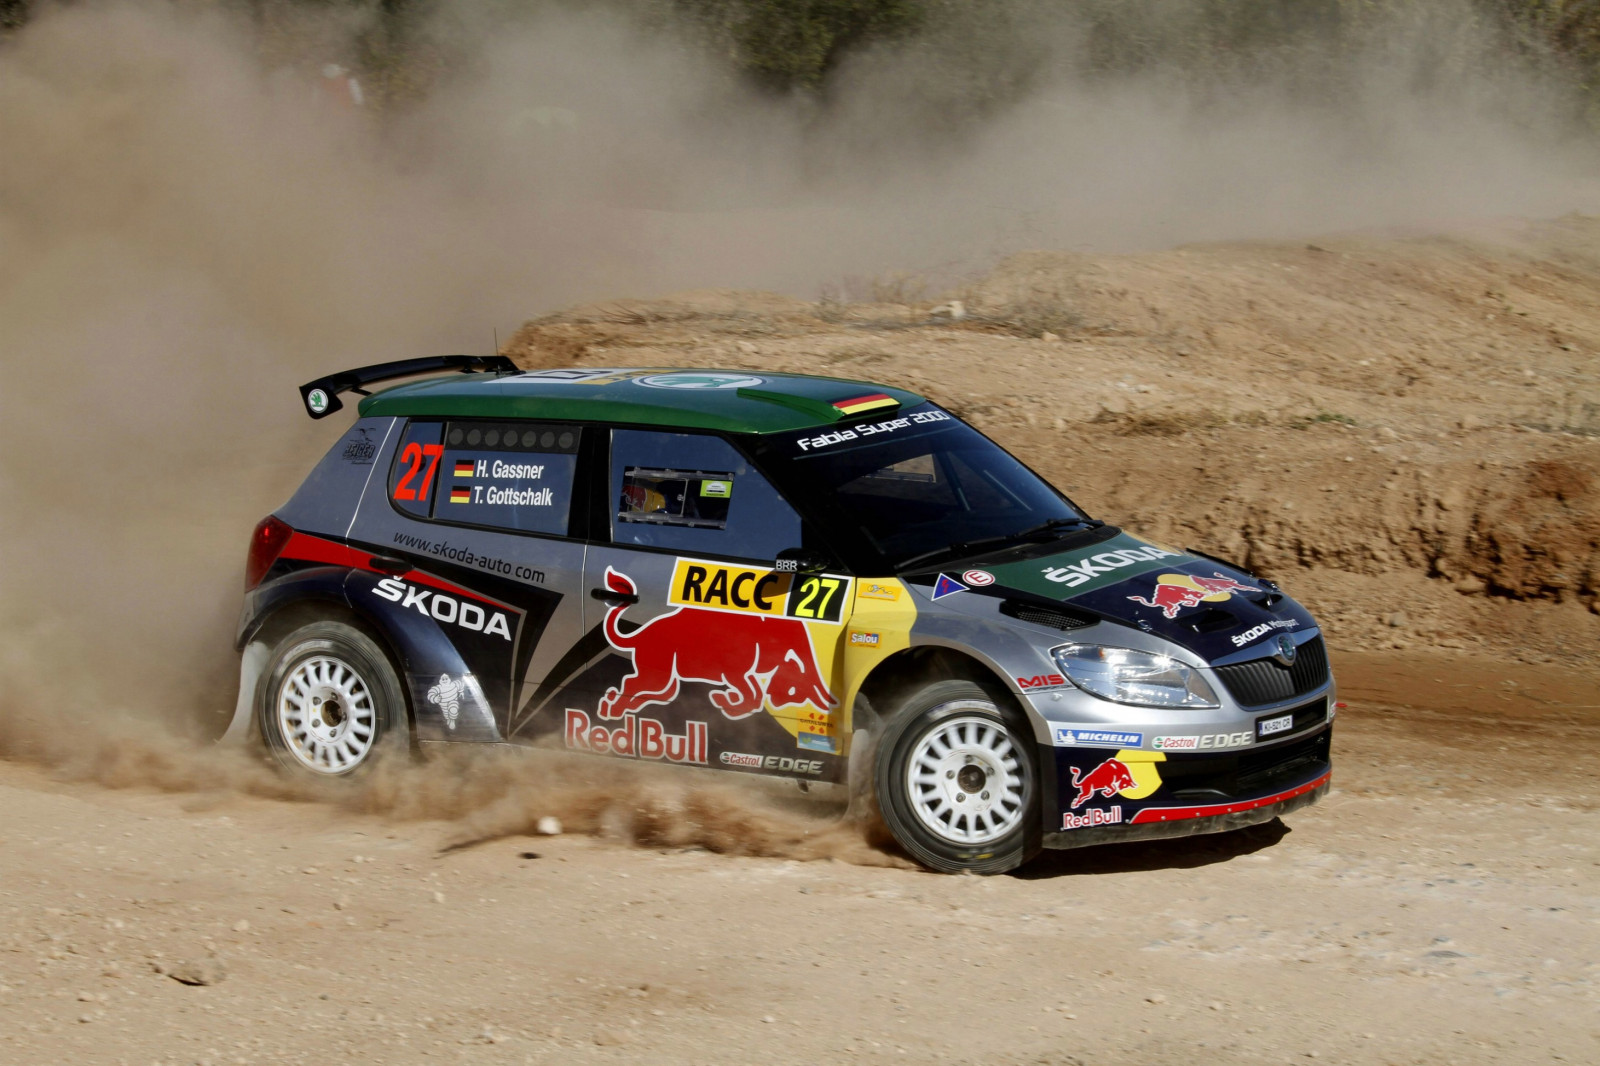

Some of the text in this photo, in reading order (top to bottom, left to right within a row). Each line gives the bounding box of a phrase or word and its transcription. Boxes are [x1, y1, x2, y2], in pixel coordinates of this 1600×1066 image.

[796, 410, 951, 450] Fabia Super 2000
[393, 442, 444, 501] 27
[476, 460, 544, 480] H. Gassner
[474, 486, 554, 506] T. Gottschalk
[776, 560, 798, 571] BRR
[1040, 546, 1181, 588] ŠKODA
[681, 565, 779, 611] RACC
[795, 576, 840, 619] 27
[371, 575, 512, 641] ŠKODA
[851, 633, 879, 644] Salou
[1231, 623, 1273, 647] ŠKODA
[1017, 674, 1065, 688] MIS
[565, 707, 708, 765] Red Bull
[1077, 732, 1140, 743] MICHELIN
[1164, 731, 1254, 749] Castrol EDGE
[729, 754, 825, 775] Castrol EDGE
[1063, 806, 1122, 829] Red Bull
